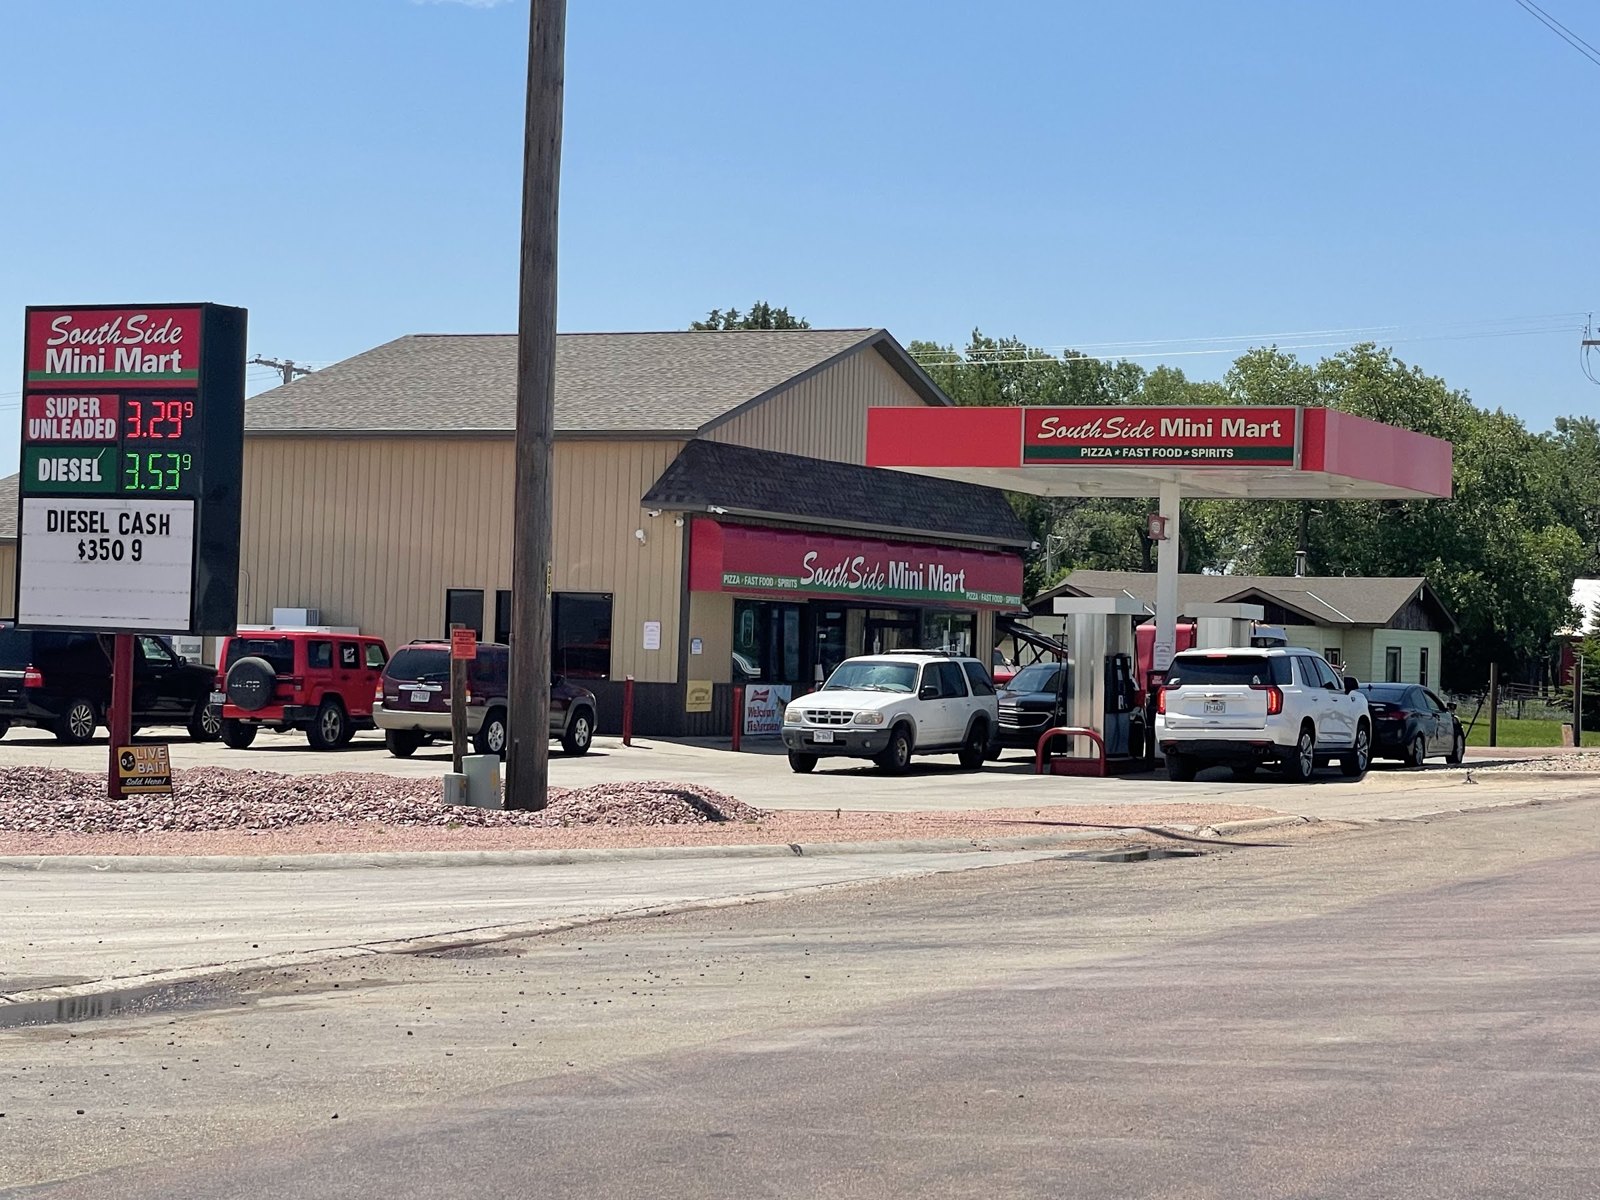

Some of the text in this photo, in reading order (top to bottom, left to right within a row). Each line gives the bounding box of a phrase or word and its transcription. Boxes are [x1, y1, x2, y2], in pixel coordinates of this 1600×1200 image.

[45, 347, 182, 374] Mini Mart
[45, 397, 101, 418] SUPER
[28, 418, 117, 439] UNLEADED
[1160, 418, 1213, 437] Mini
[1221, 418, 1281, 438] Mart
[1080, 447, 1234, 458] PIZZA FAST FOOD SPIRITS
[38, 457, 102, 482] DIESEL
[47, 509, 170, 536] DIESEL CASH
[78, 538, 124, 561] $350
[723, 574, 798, 589] PIZZA FAST FOOD SPIRITS
[888, 560, 924, 591] Mini
[928, 563, 966, 594] Mart
[136, 747, 166, 760] LIVE
[137, 761, 167, 774] BAIT
